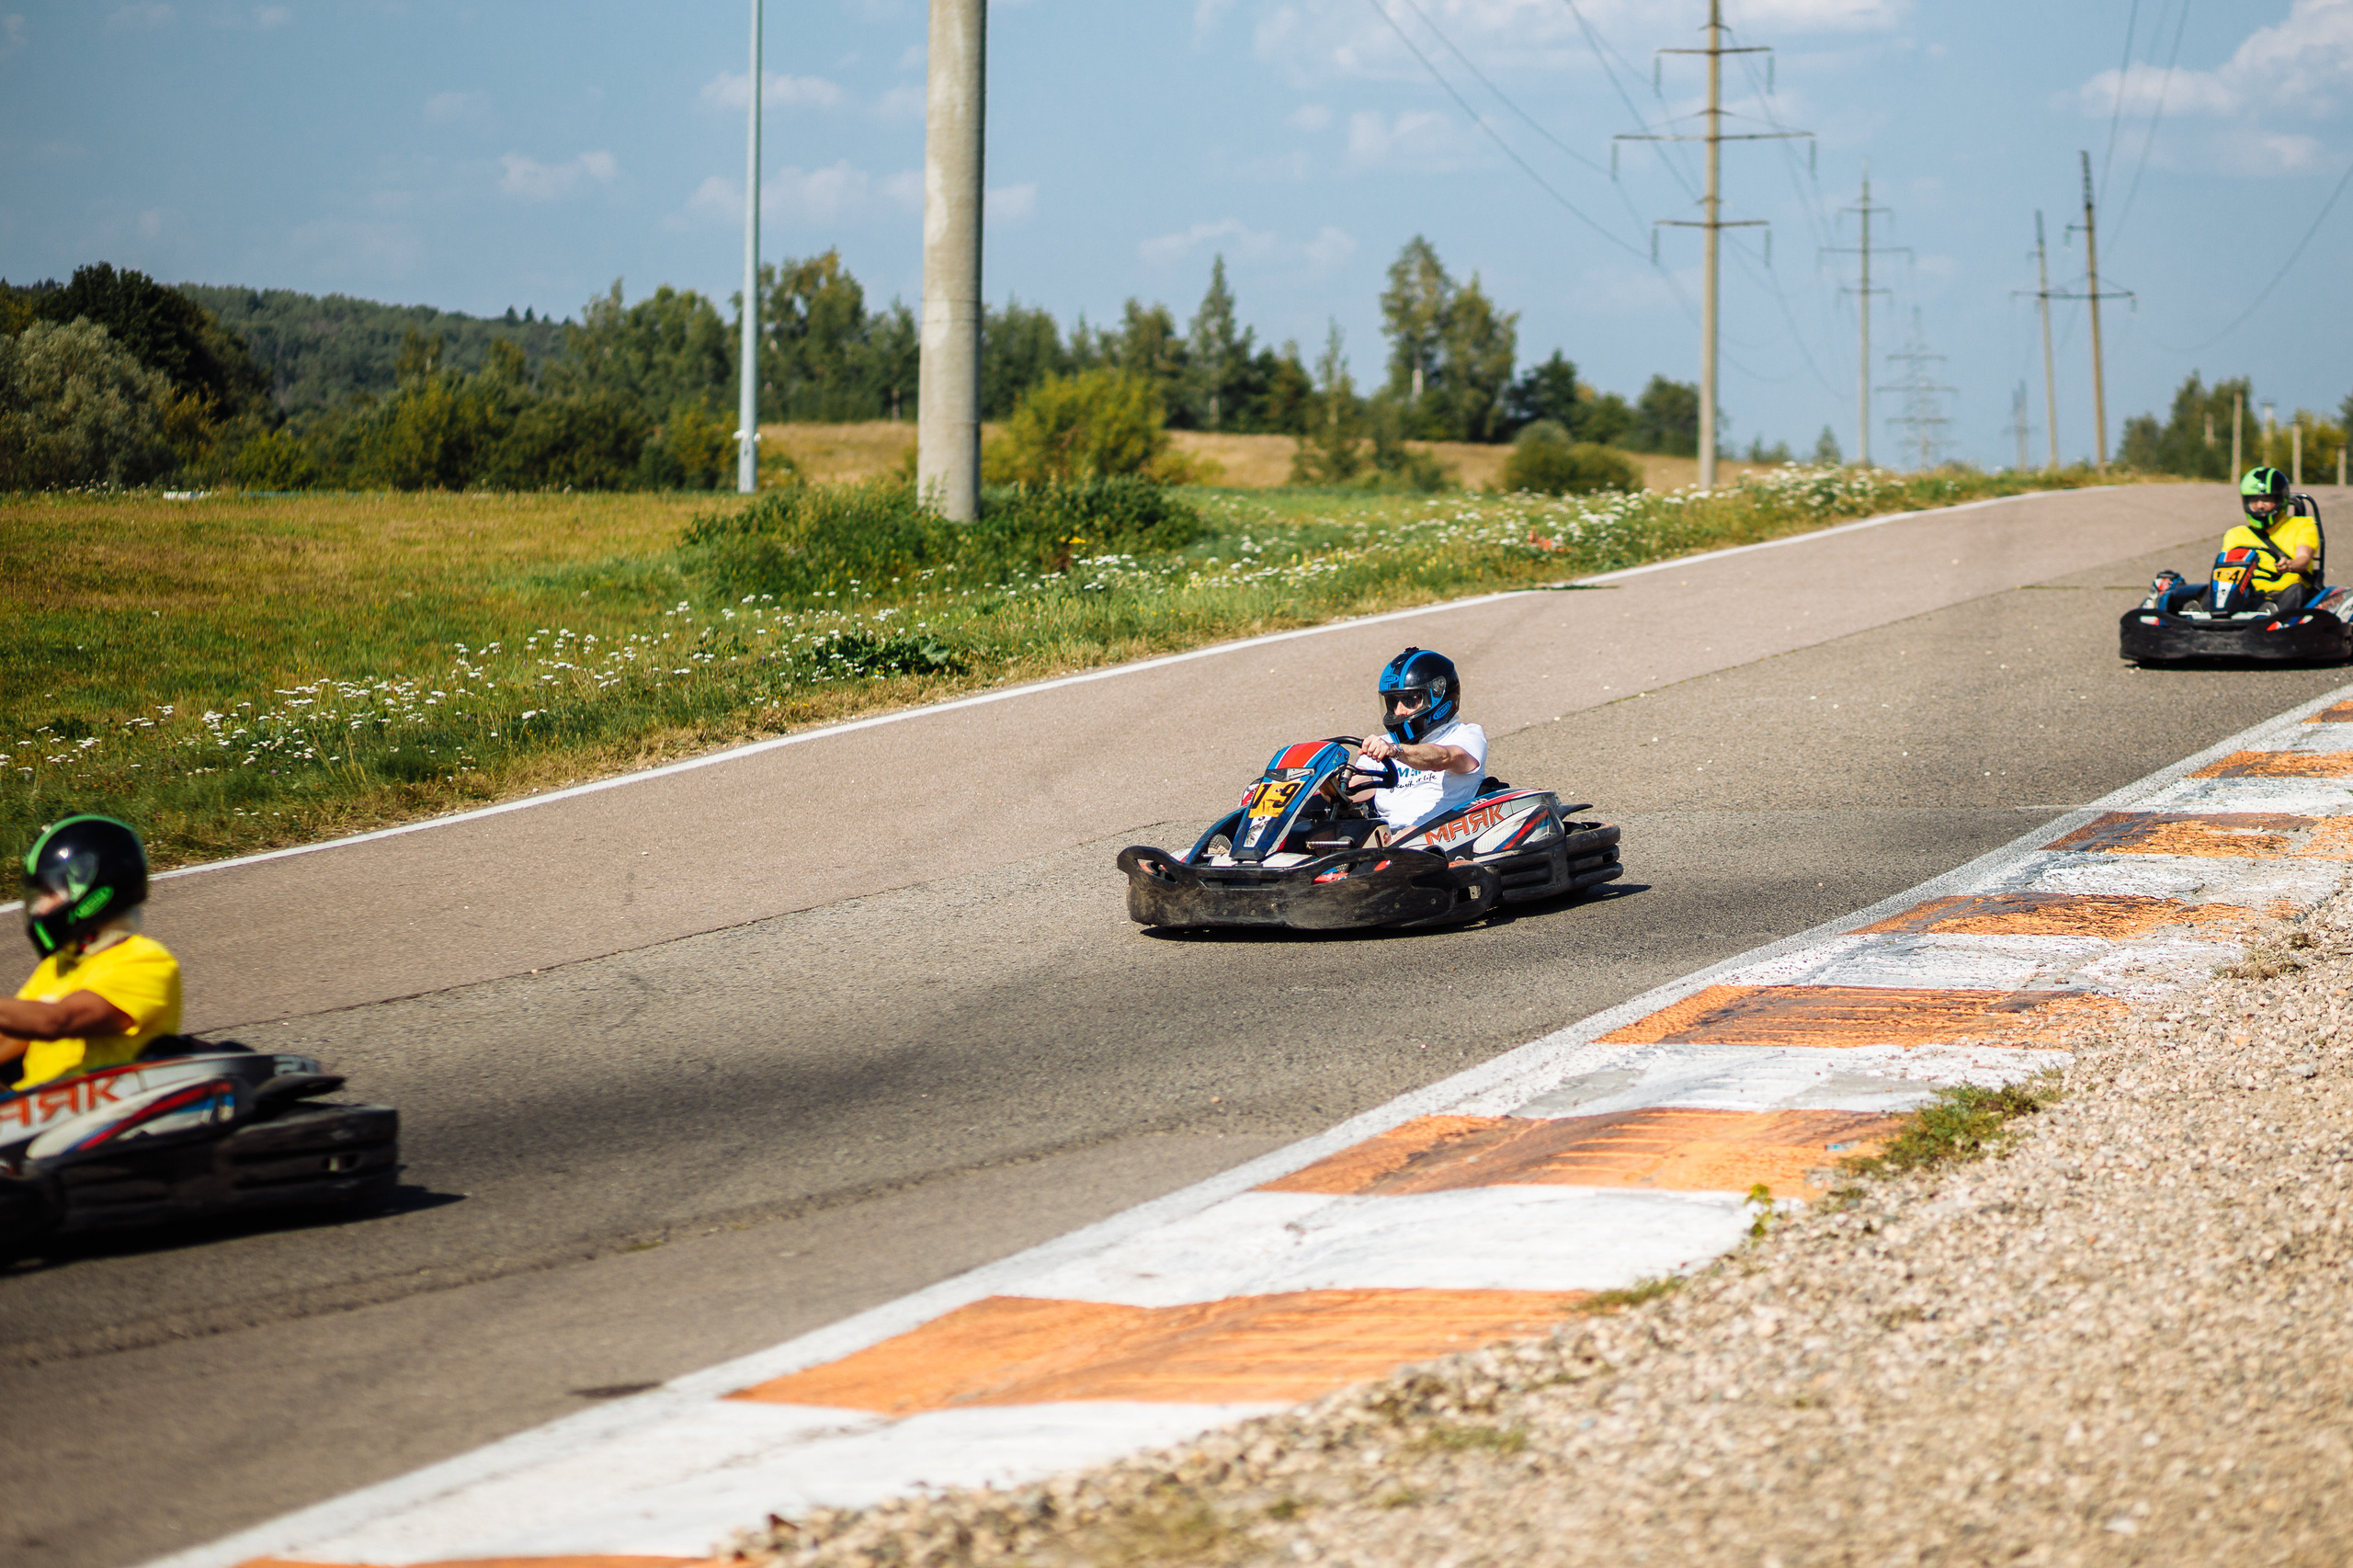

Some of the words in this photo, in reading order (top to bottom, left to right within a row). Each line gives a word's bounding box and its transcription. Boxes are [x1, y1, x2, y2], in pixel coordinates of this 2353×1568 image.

[2217, 570, 2241, 584] 14
[1250, 783, 1302, 809] 19
[1425, 802, 1506, 846] МАЯК
